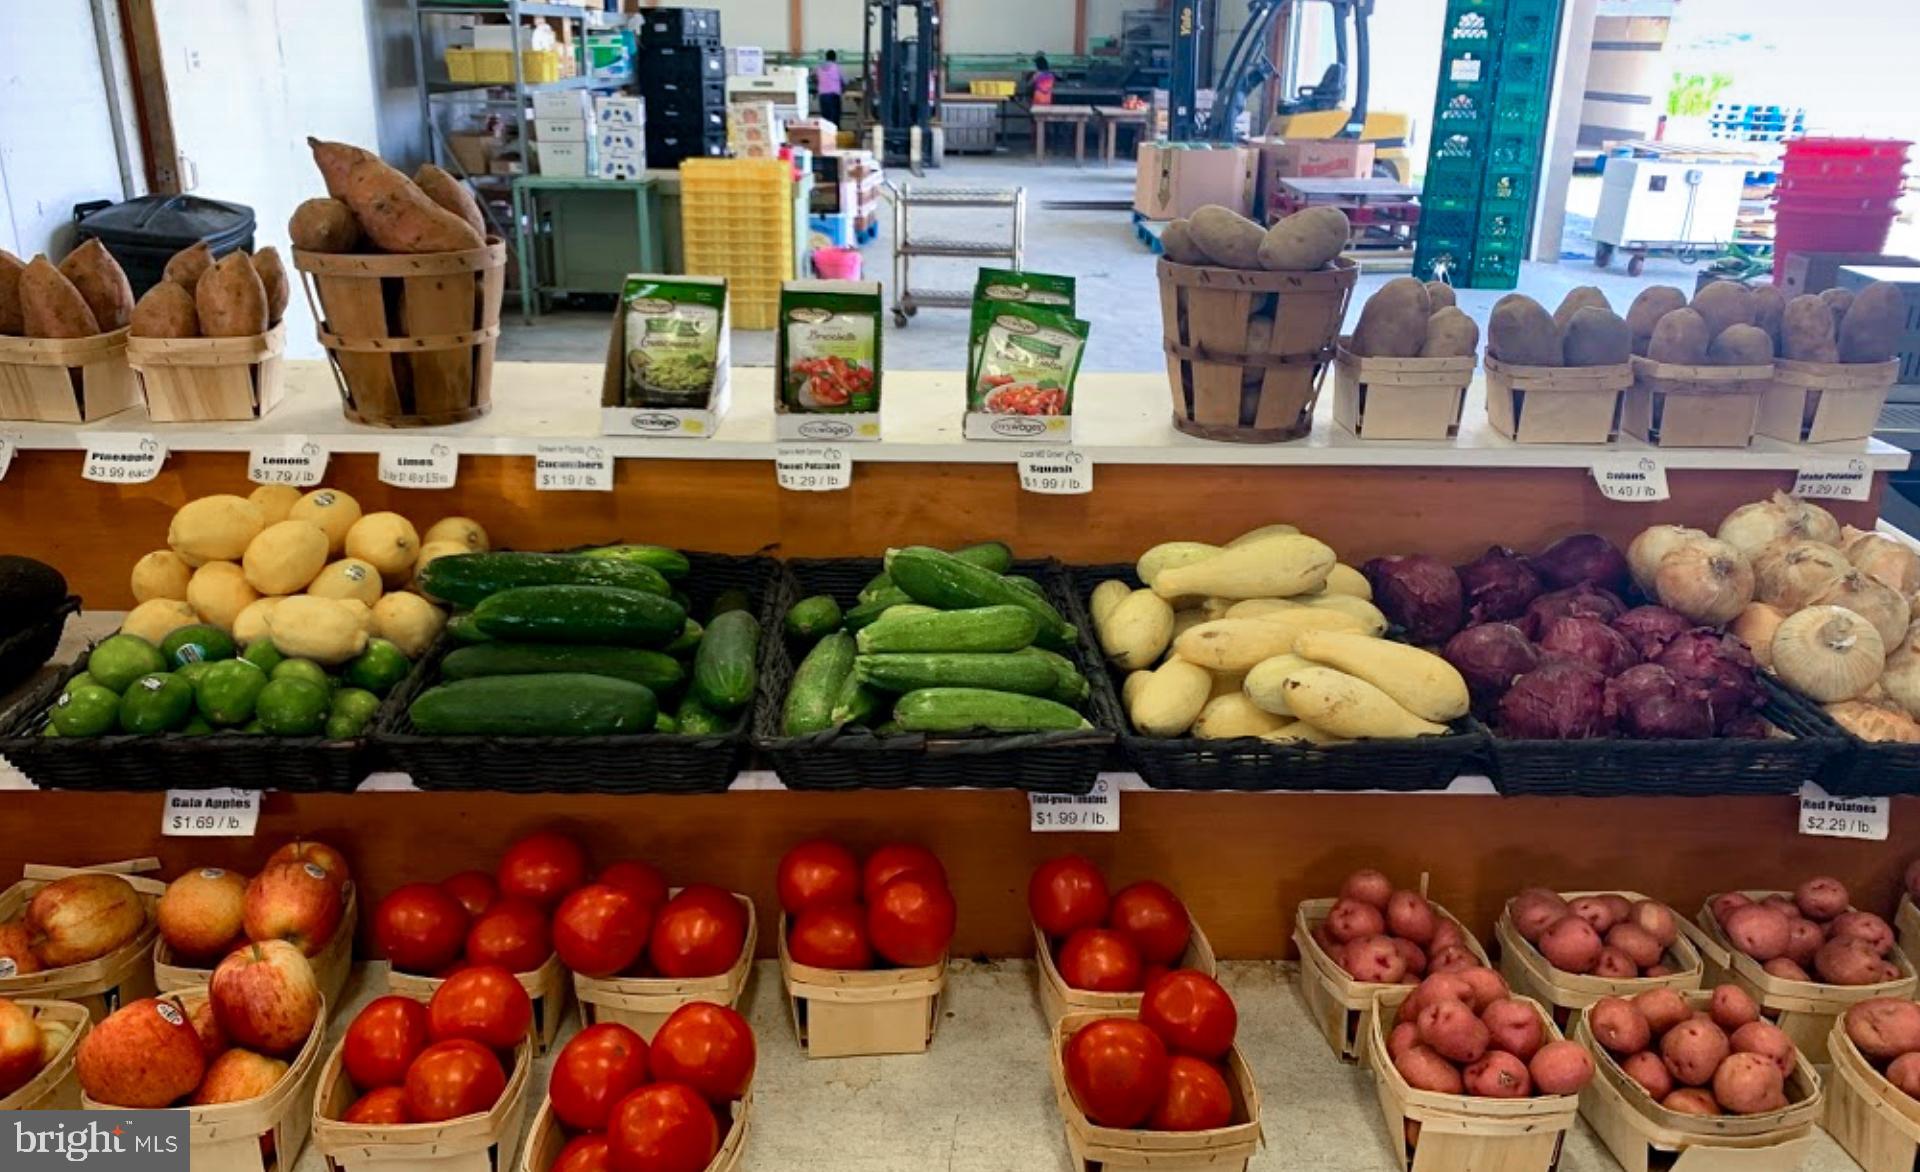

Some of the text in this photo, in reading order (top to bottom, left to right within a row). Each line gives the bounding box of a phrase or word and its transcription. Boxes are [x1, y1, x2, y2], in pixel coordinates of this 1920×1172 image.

[91, 452, 154, 462] Pineapple
[262, 456, 310, 466] Lemons
[396, 457, 434, 467] Limes
[537, 460, 604, 470] Cucumbers
[1028, 464, 1073, 475] Squash
[253, 468, 293, 482] $1.79
[1606, 471, 1646, 481] Onions
[1023, 476, 1058, 490] $1.99
[170, 797, 252, 810] Gala Apples
[1802, 799, 1877, 814] Red Potatoes
[172, 815, 215, 830] $1.69
[1036, 811, 1078, 826] $1.99
[1091, 811, 1109, 826] lb.
[1806, 816, 1846, 832] $2.29
